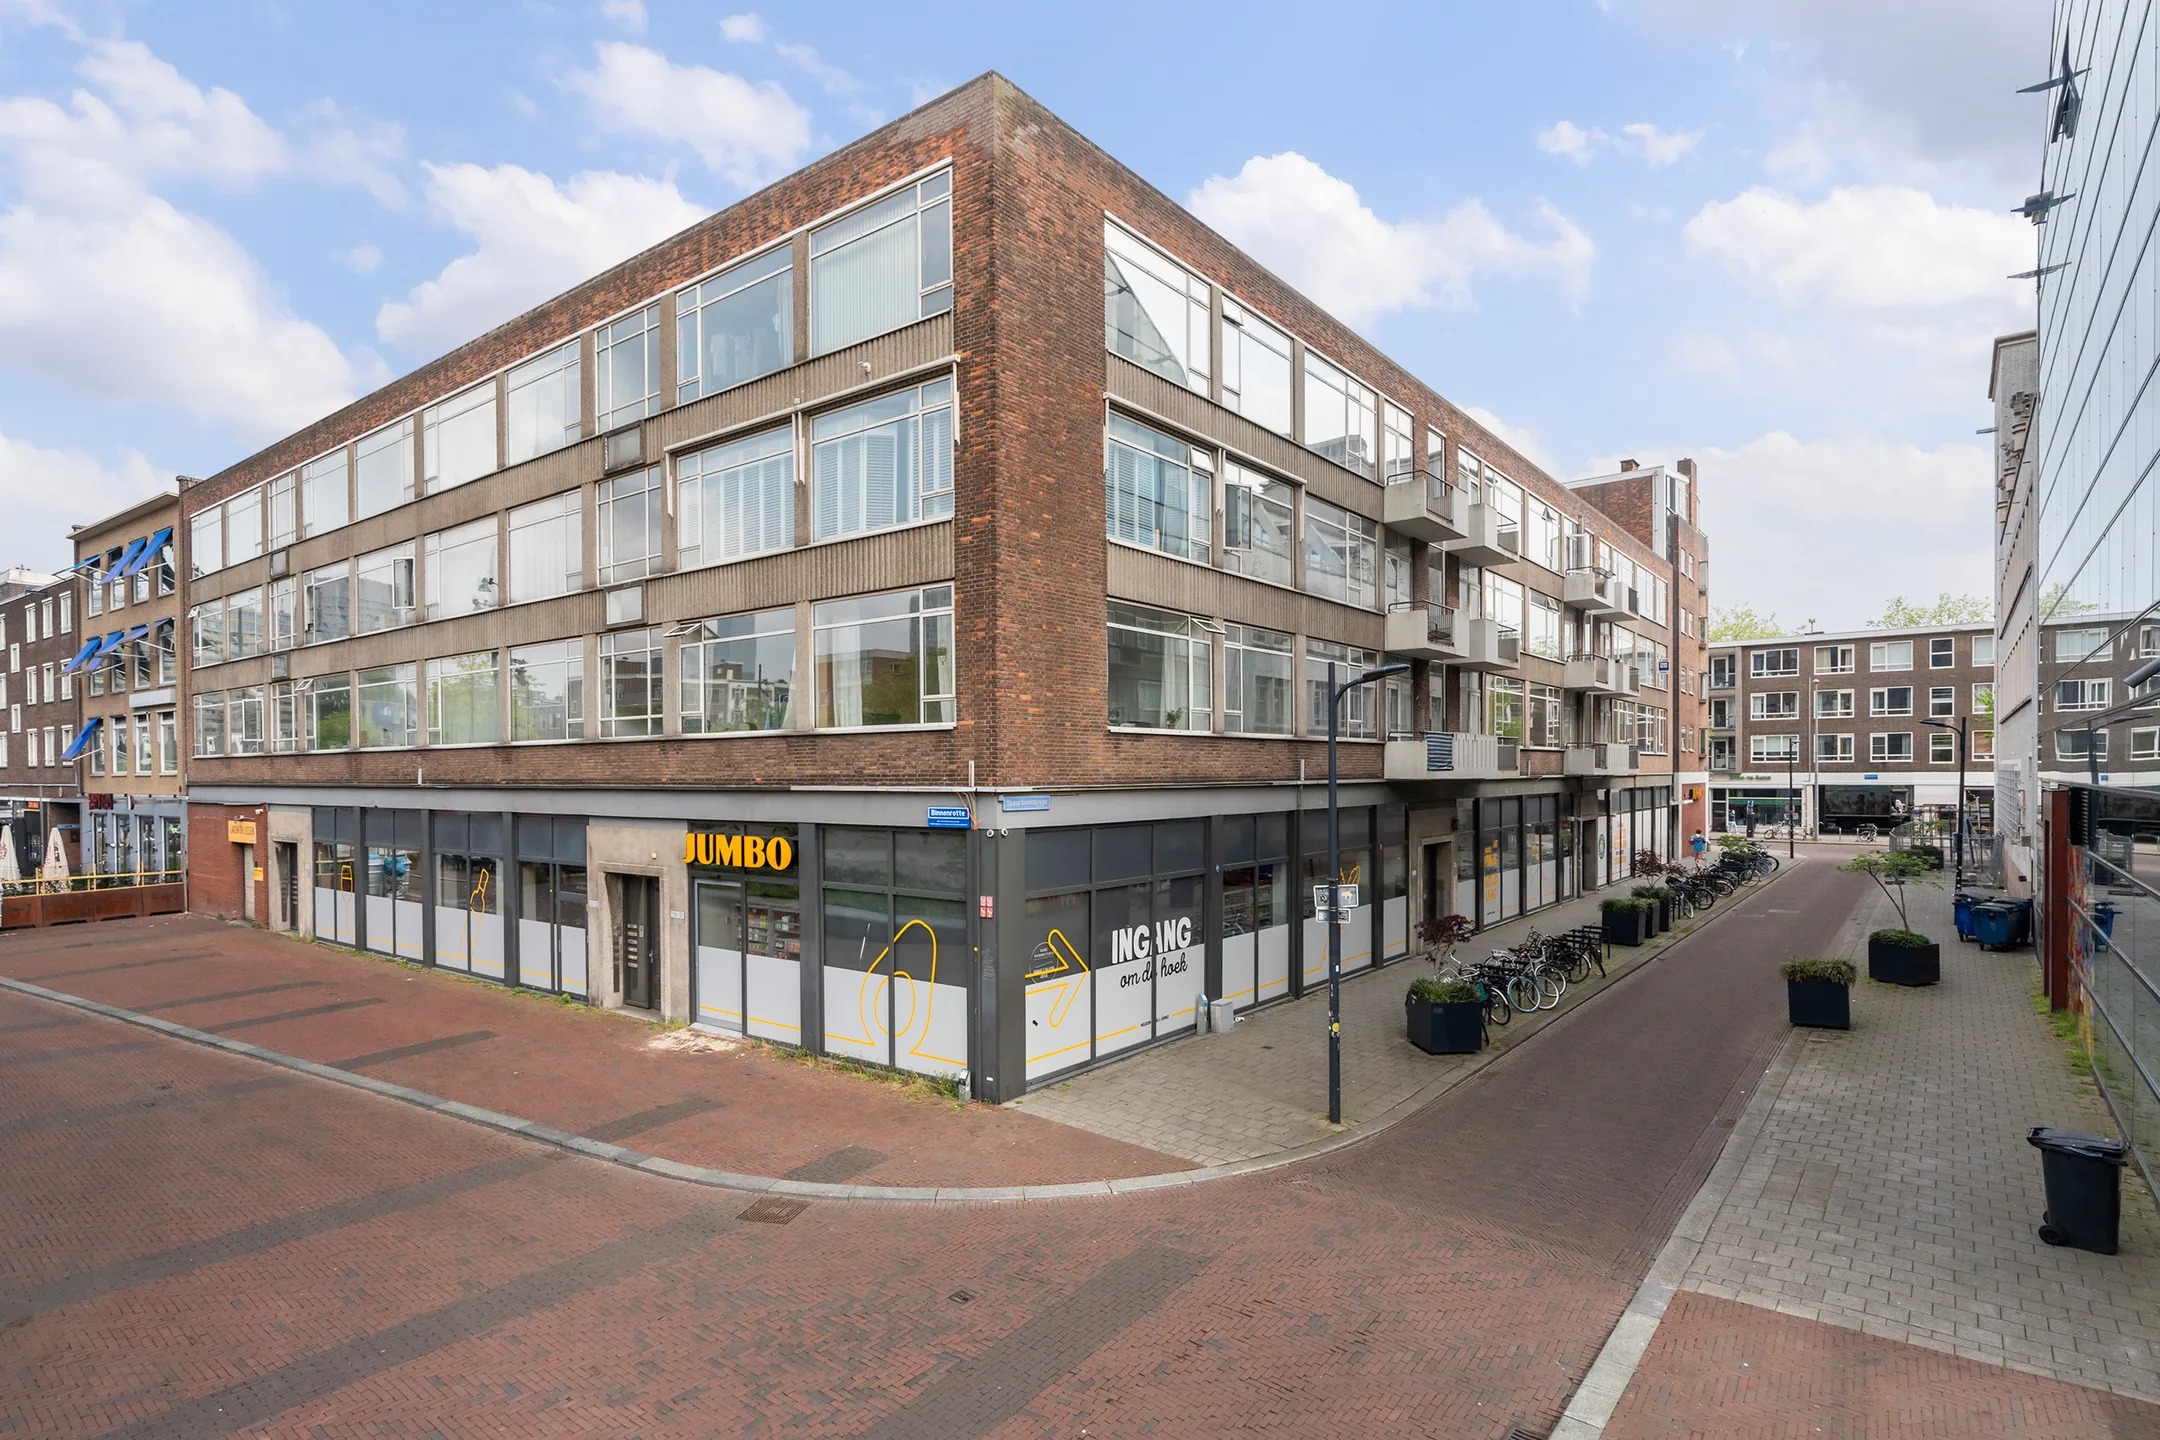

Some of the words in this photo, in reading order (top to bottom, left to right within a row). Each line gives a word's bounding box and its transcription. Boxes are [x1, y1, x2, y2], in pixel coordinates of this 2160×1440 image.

[682, 832, 792, 871] JUMBO
[1112, 916, 1192, 964] INGANG
[1120, 972, 1141, 988] om
[1142, 961, 1157, 982] d
[1160, 952, 1188, 978] hoek
